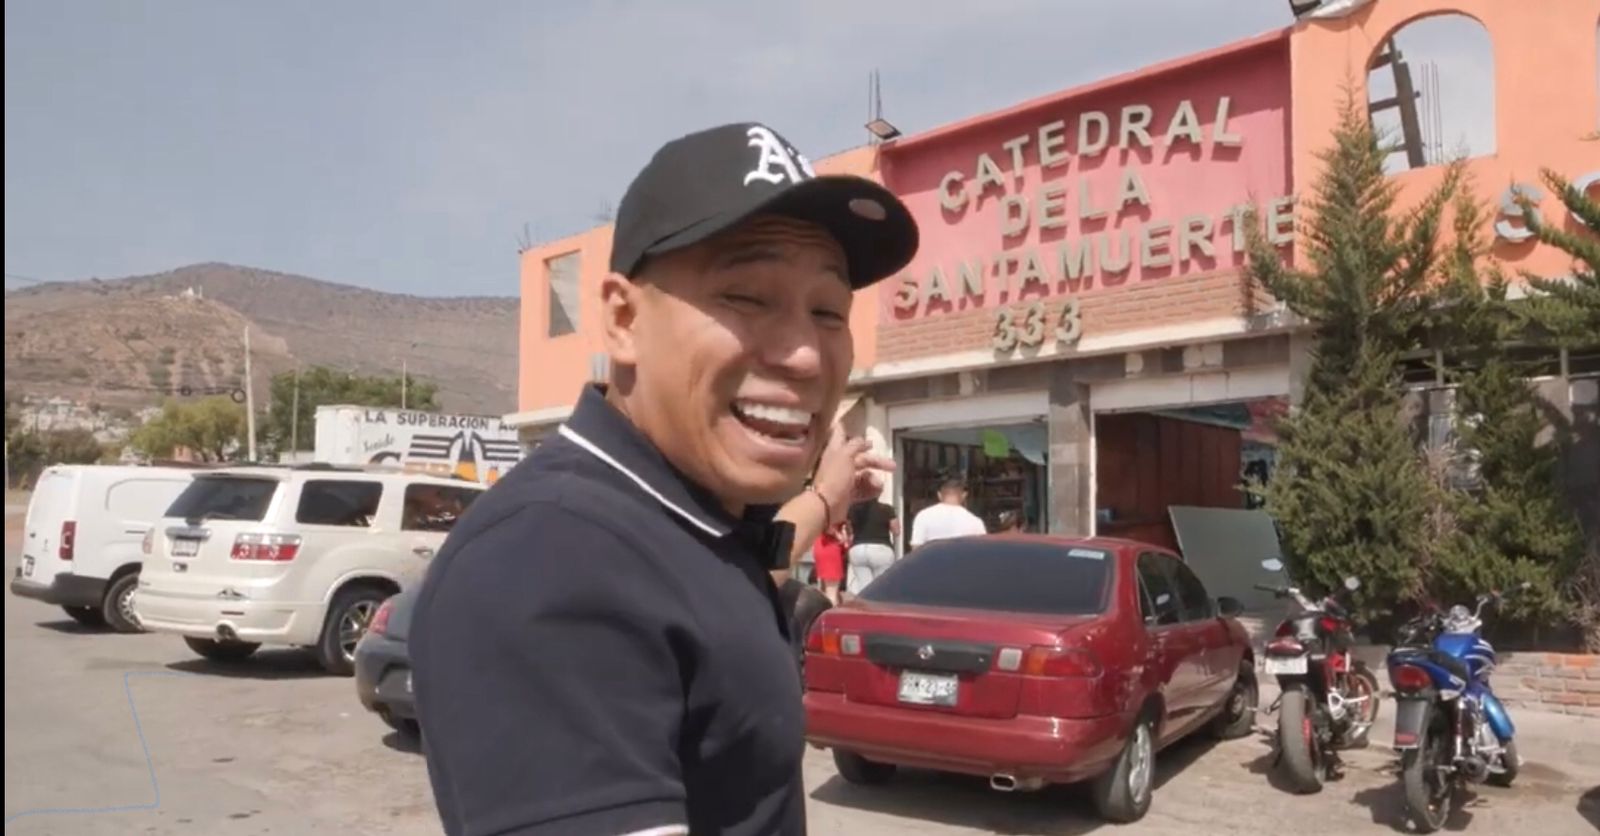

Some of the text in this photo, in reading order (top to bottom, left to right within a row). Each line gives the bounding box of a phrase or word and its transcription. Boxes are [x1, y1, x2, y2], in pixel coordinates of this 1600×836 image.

[939, 96, 1247, 212] CATEDRAL
[993, 298, 1083, 354] 333
[365, 410, 388, 425] LA
[397, 412, 490, 430] SUPERACION
